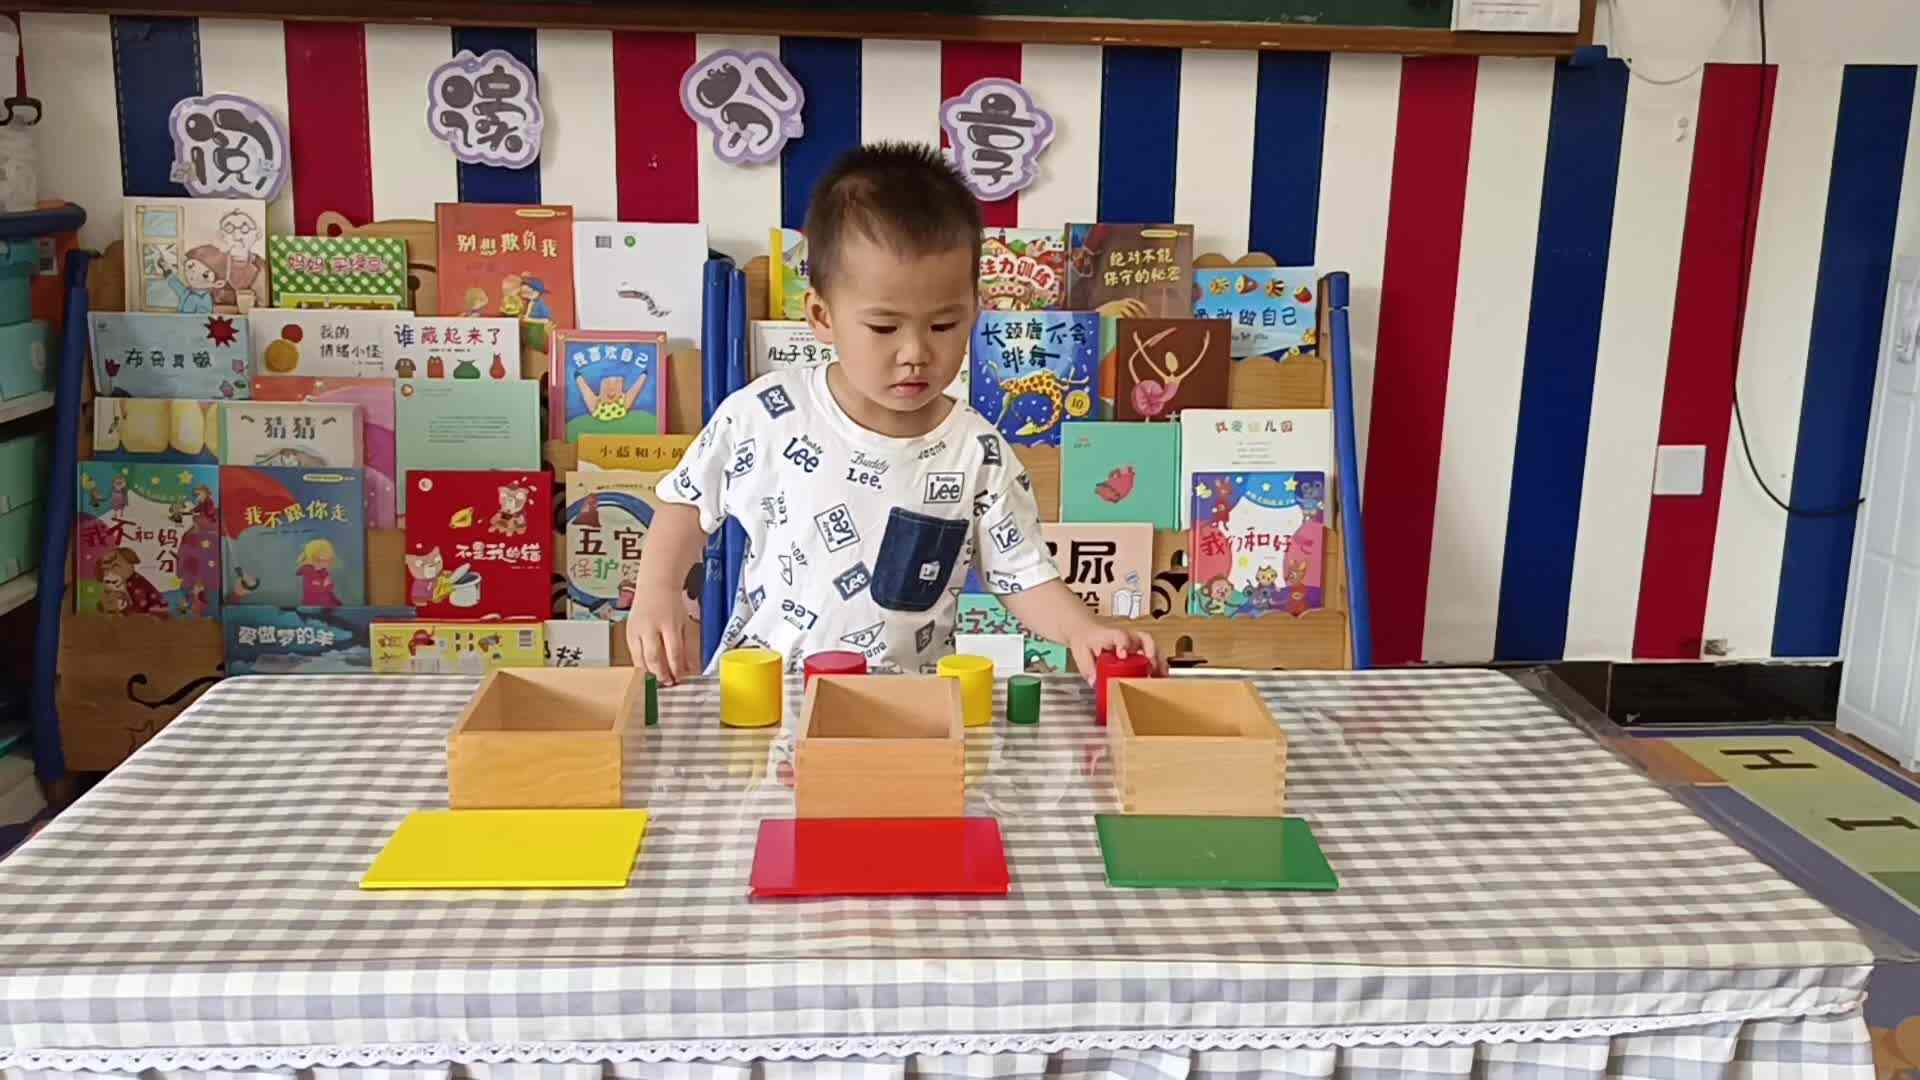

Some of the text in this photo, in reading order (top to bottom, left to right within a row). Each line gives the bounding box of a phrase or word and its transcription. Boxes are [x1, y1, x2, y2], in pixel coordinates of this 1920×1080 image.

[185, 108, 274, 191] 阅
[696, 62, 788, 149] 分
[956, 92, 1036, 186] 享
[457, 229, 558, 257] 别想欺负我
[320, 325, 349, 339] 我的
[394, 323, 501, 348] 谁藏起来了
[981, 317, 1087, 348] 长颈鹿不会
[1001, 345, 1060, 373] 跳舞
[264, 416, 315, 439] 猜猜
[783, 436, 820, 473] Lee
[849, 450, 890, 476] Buddy
[929, 482, 961, 500] Lee
[244, 499, 349, 528] 我不跟你走
[455, 541, 541, 563] 不是我的猫
[575, 527, 644, 560] 五官
[781, 599, 819, 630] Lee
[1719, 749, 1819, 770] H
